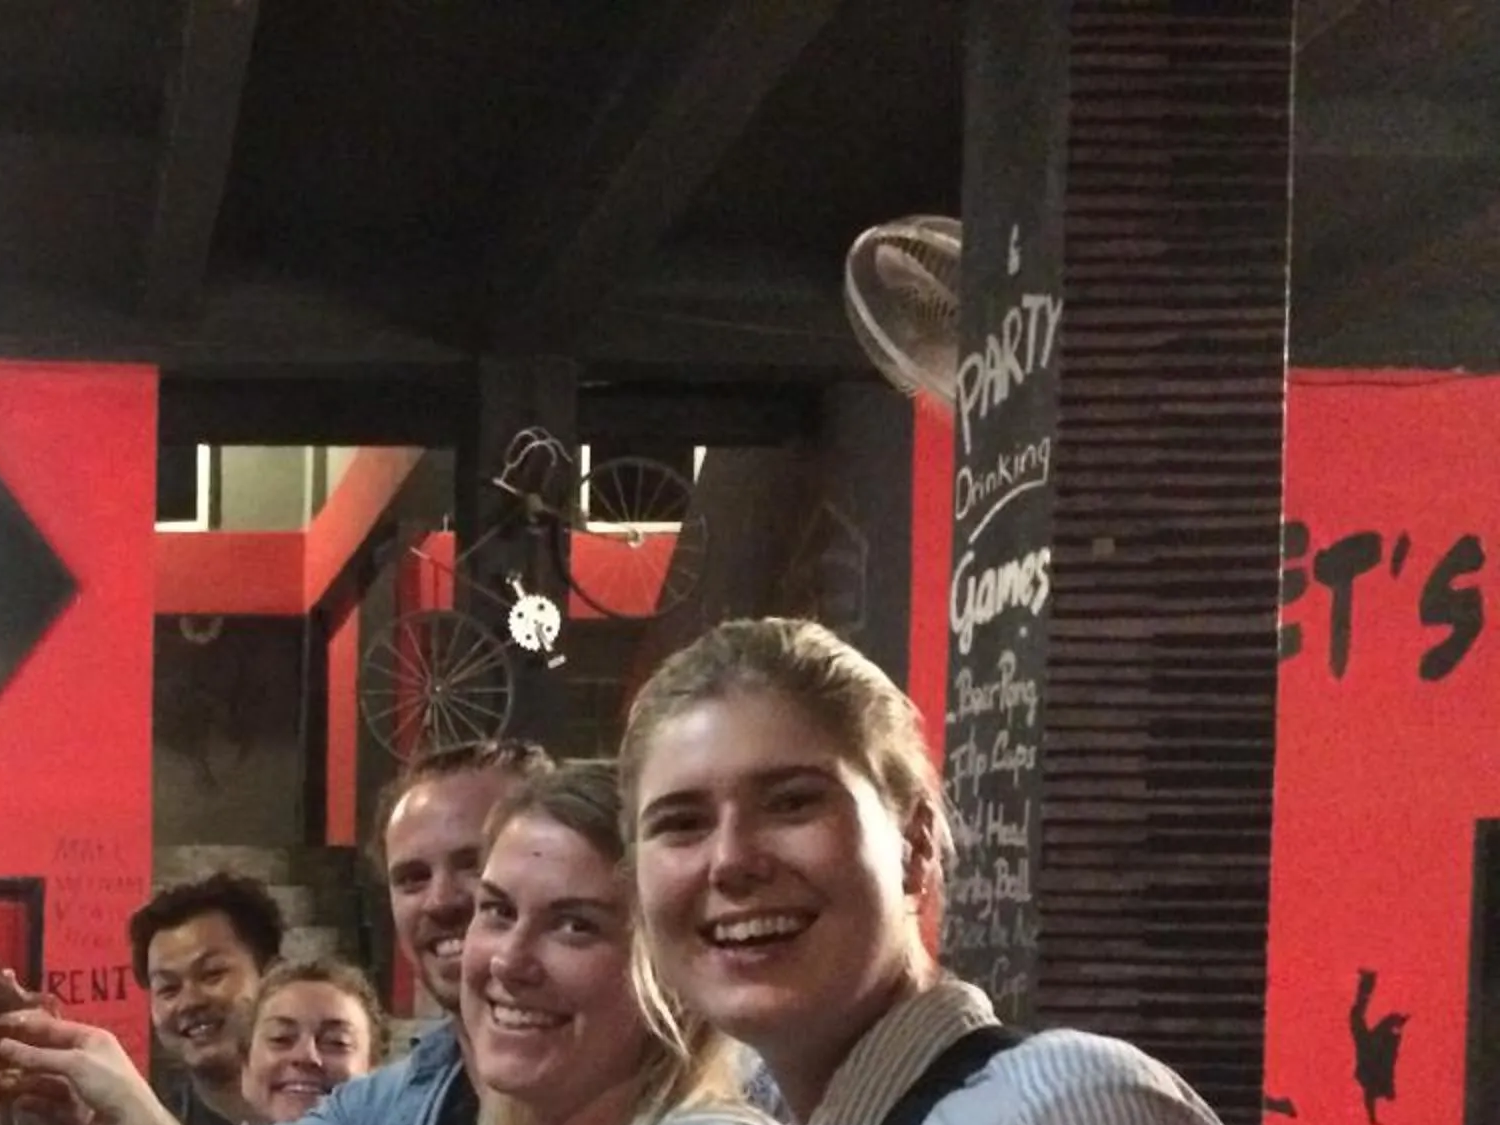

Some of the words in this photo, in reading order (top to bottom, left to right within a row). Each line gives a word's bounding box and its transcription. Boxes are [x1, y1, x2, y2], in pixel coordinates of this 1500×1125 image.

[956, 293, 1063, 454] PARTY
[955, 437, 1051, 520] Drinking
[46, 964, 133, 1006] RENT
